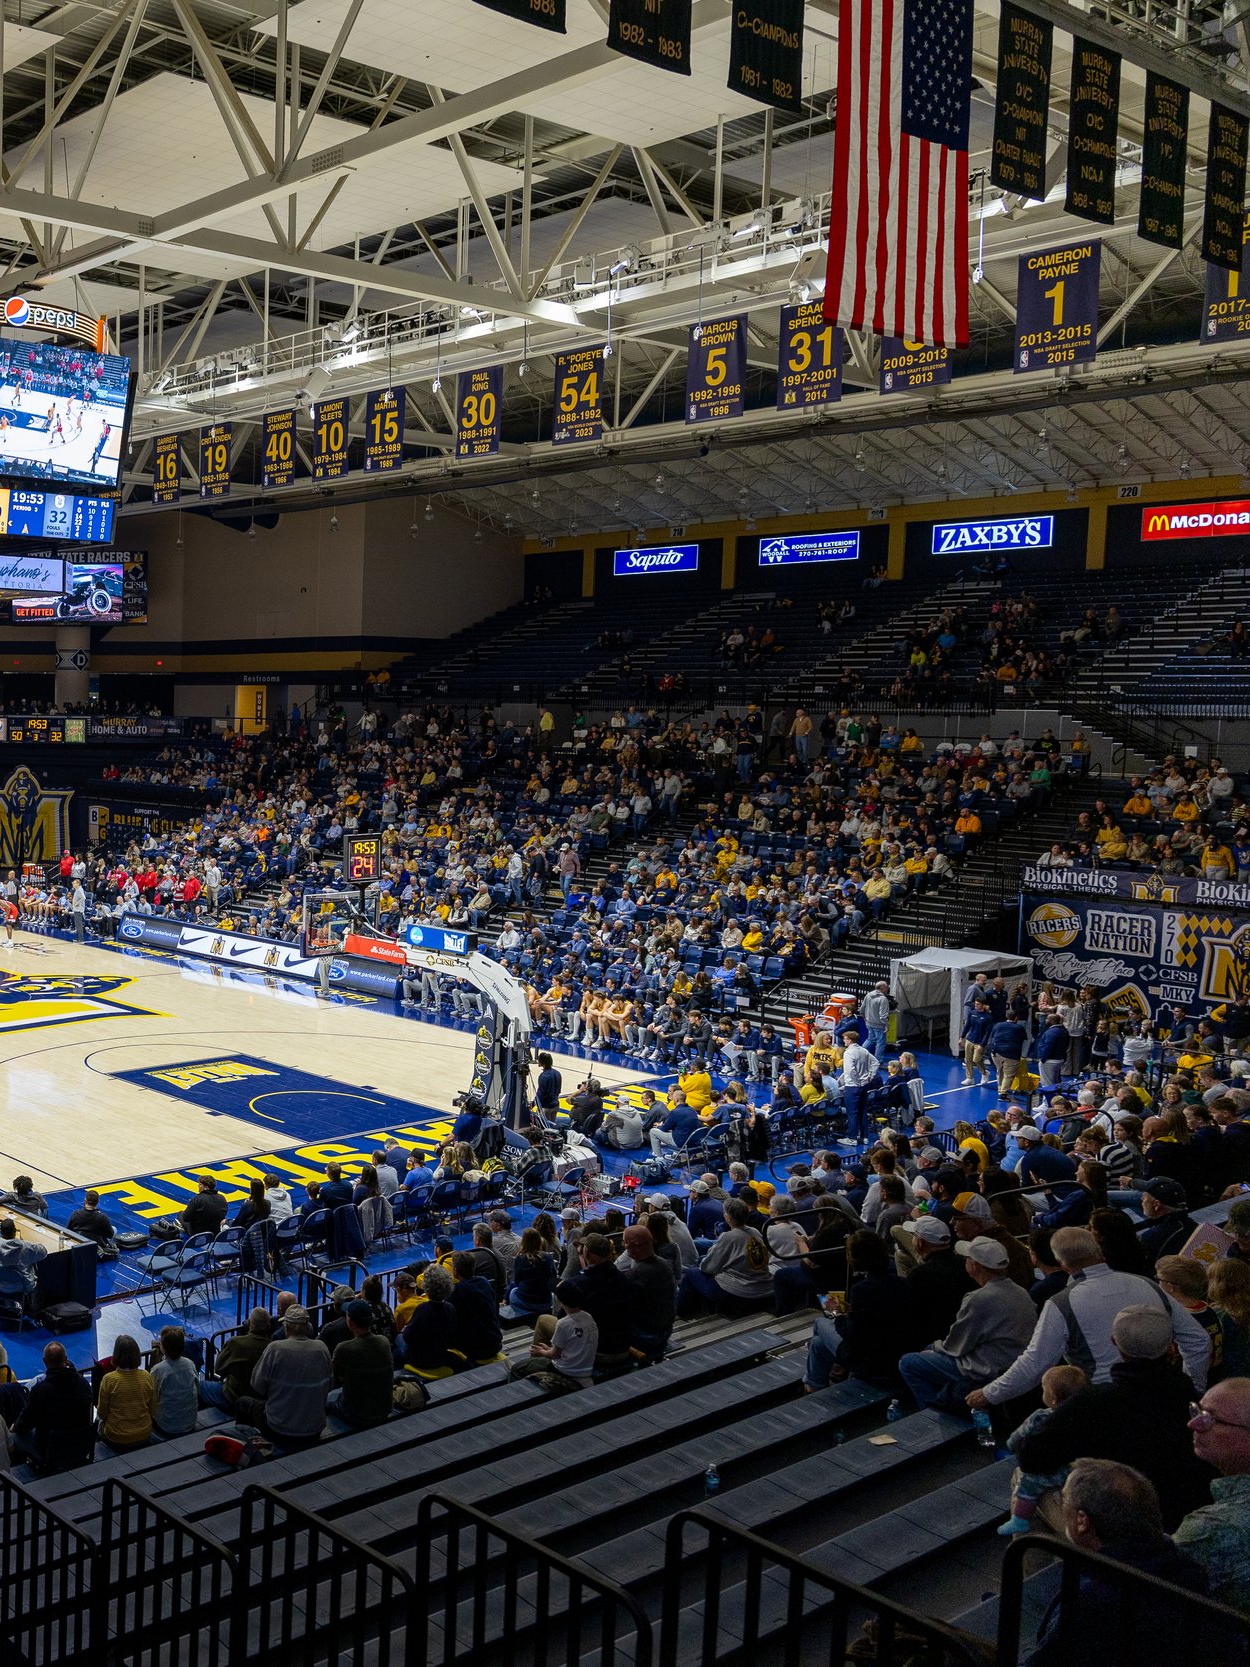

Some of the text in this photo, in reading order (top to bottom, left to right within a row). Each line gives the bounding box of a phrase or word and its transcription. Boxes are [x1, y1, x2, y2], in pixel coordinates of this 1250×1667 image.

[1010, 18, 1044, 45] MURRAY
[619, 21, 682, 60] 1982 1983
[1014, 37, 1040, 58] STATE
[1028, 246, 1092, 270] CAMERON
[1038, 262, 1079, 280] PAYNE
[1044, 281, 1065, 326] 1
[34, 308, 78, 328] pepsi
[701, 322, 738, 336] MARCUS
[1020, 324, 1092, 348] 2013-2015
[701, 332, 735, 347] BROWN
[788, 326, 833, 372] 31
[884, 348, 948, 370] 2009-2013
[1047, 350, 1075, 364] 2015
[568, 361, 594, 374] JONES
[705, 347, 727, 387] 5
[472, 372, 489, 382] PAUL
[782, 368, 837, 387] 1997-2001
[909, 372, 933, 385] 2013
[472, 382, 489, 392] KING
[560, 372, 600, 412] 54
[690, 384, 741, 402] 1992-1996
[805, 390, 827, 402] 2014
[319, 401, 344, 413] LAMONT
[374, 400, 398, 410] MARTIN
[462, 392, 496, 428] 30
[267, 412, 292, 424] STEWART
[320, 411, 342, 422] SLEETS
[556, 408, 601, 424] 1988-1992
[266, 422, 292, 432] JOHNSON
[371, 411, 398, 444] 15
[458, 426, 496, 440] 1988-1991
[317, 422, 344, 453] 10
[266, 432, 292, 462] 40
[156, 452, 177, 481] 16
[205, 444, 228, 474] 19
[12, 492, 44, 504] 19:53
[1121, 487, 1138, 498] 220
[50, 510, 67, 524] 32
[1170, 512, 1250, 528] McDona
[940, 520, 1041, 552] ZAXBY'S
[792, 542, 817, 550] ROOFING
[824, 539, 856, 548] EXTERIORS
[91, 551, 131, 563] RACERS
[626, 550, 684, 570] Saputo
[762, 550, 790, 558] WOODALL
[16, 608, 54, 616] GET FITTED
[243, 674, 280, 682] Restrooms
[28, 720, 48, 729] 19:53
[92, 726, 116, 735] HOME
[116, 726, 124, 734] &
[126, 726, 148, 734] AUTO
[12, 731, 22, 741] 50
[50, 732, 62, 742] 32
[354, 842, 376, 854] 19:53
[353, 856, 374, 878] 24
[1023, 867, 1118, 890] BioKinetics
[1023, 882, 1118, 896] PHYSICAL THERAPY
[1028, 917, 1080, 936] RACERS
[1090, 913, 1152, 937] RACER
[1088, 932, 1152, 954] NATION
[1100, 961, 1134, 976] Place
[1159, 969, 1198, 982] CFSB
[350, 970, 397, 984] www.parkerford.com
[1162, 986, 1193, 1002] MKY
